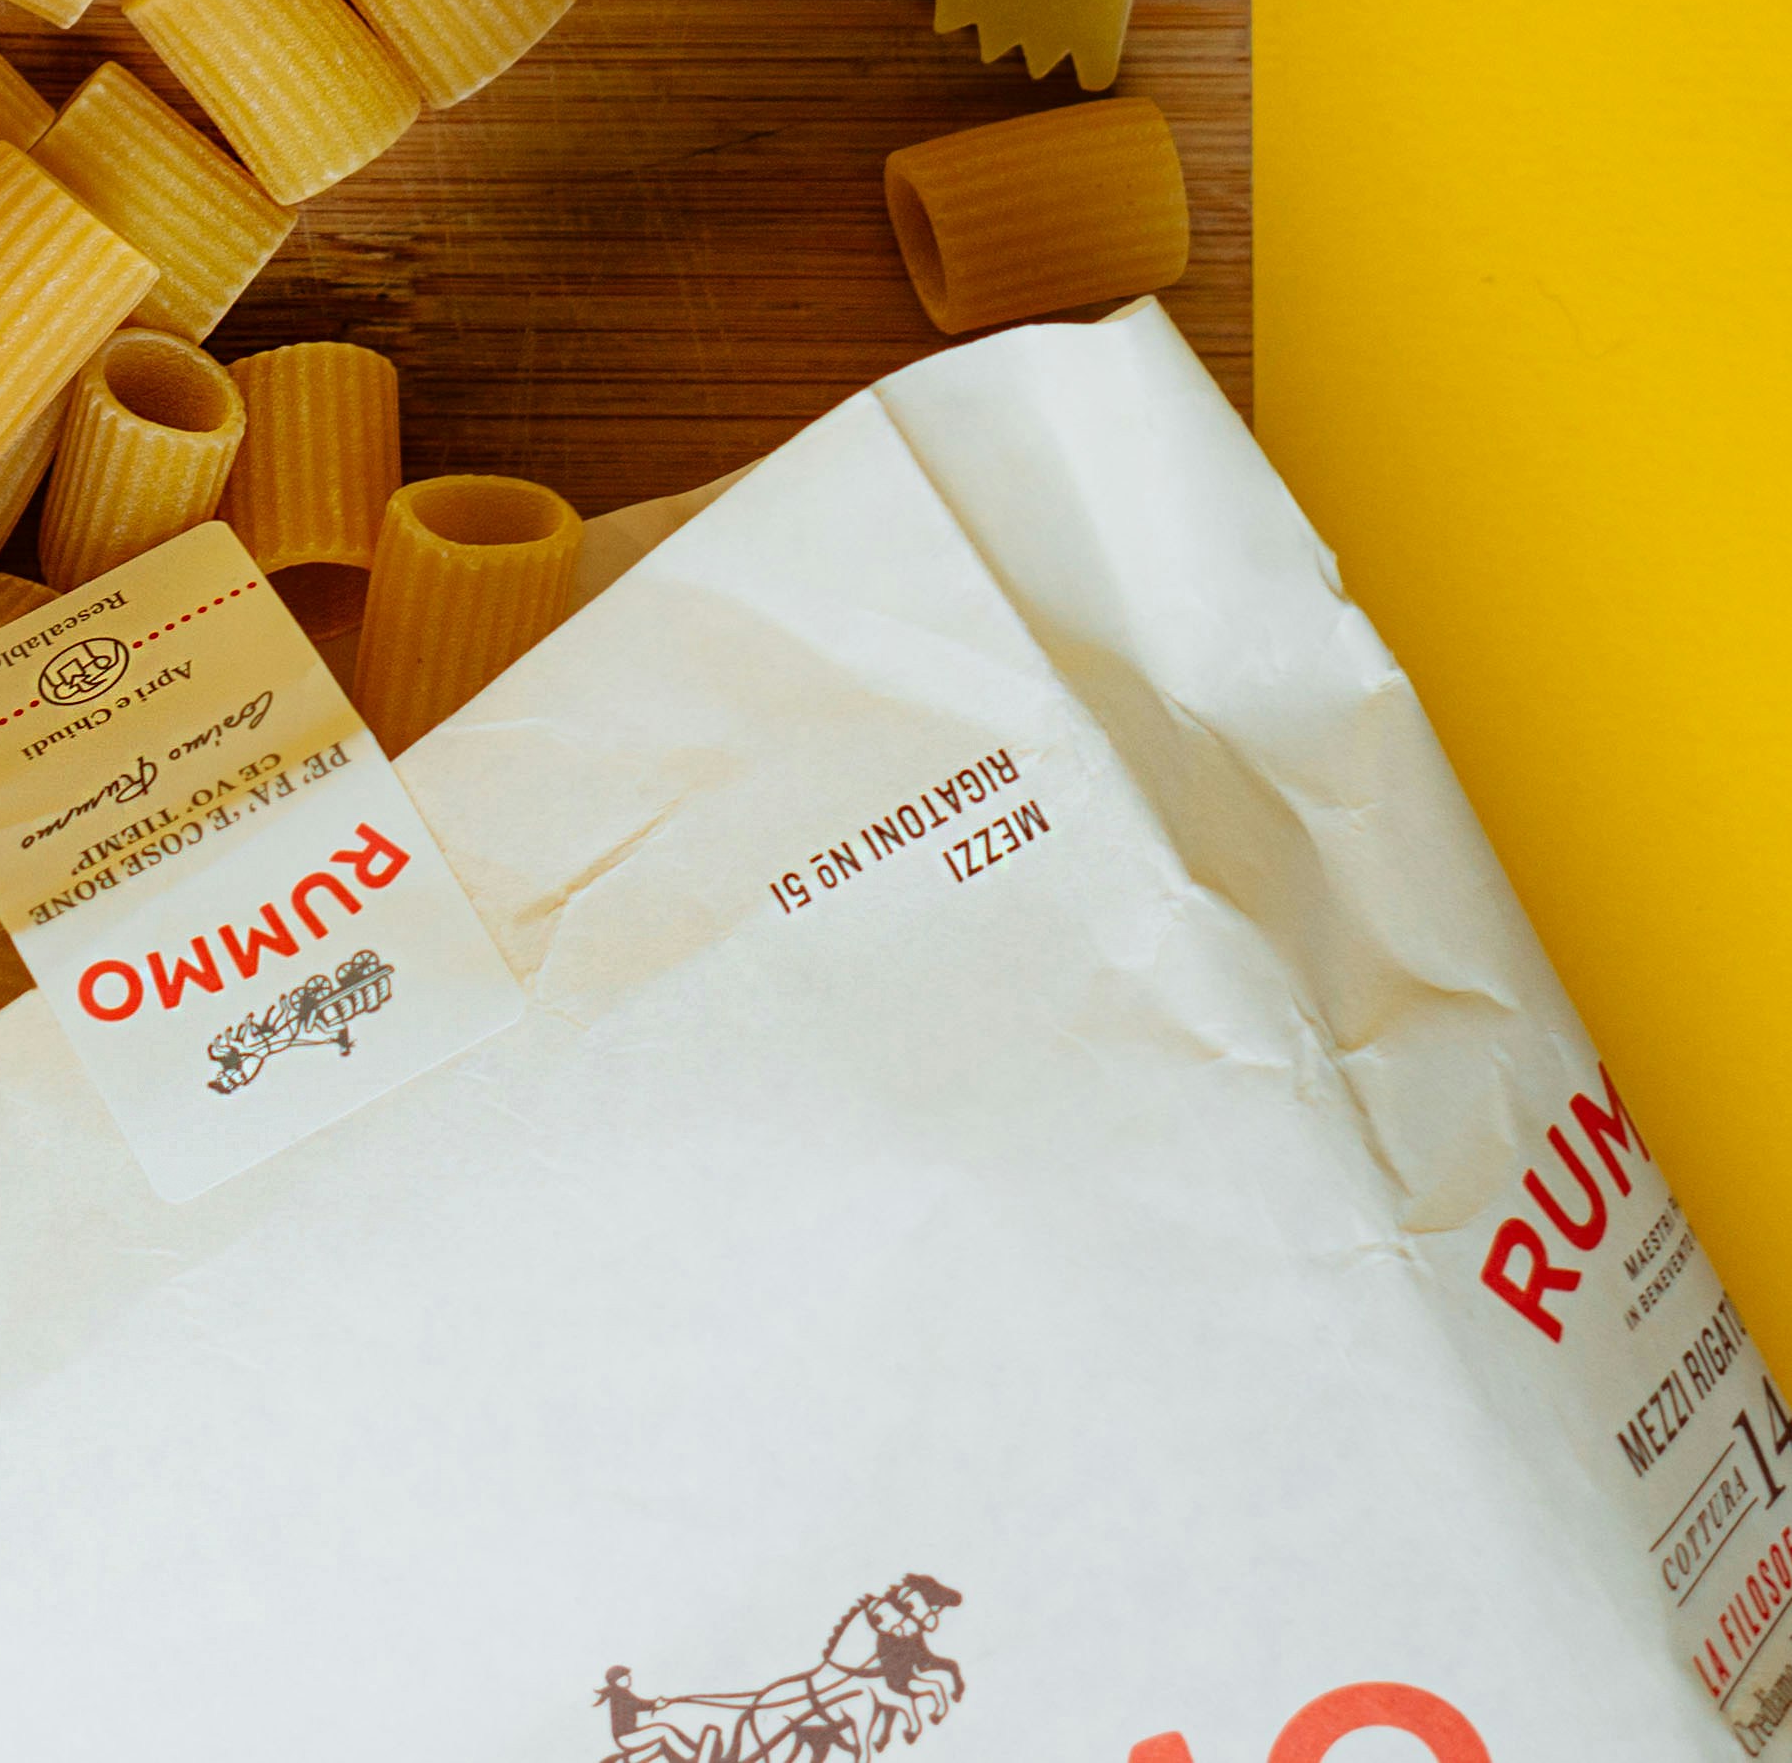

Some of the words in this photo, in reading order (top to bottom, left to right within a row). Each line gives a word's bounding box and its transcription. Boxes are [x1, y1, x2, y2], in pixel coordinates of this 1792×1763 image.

[115, 695, 131, 710] e
[136, 660, 193, 705] Apri
[21, 707, 112, 761] Chiudi
[238, 752, 283, 780] CE
[860, 748, 1020, 861] RIGATONI
[120, 820, 204, 878] COSE
[942, 800, 1051, 884] MEZZI
[28, 863, 122, 926] BONE
[77, 822, 411, 1022] RUMMO
[769, 872, 812, 914] 51
[1623, 1304, 1642, 1331] IN
[1616, 1369, 1695, 1477] MEZZI
[1662, 1465, 1748, 1591] COTTURA
[1693, 1637, 1731, 1698] LA
